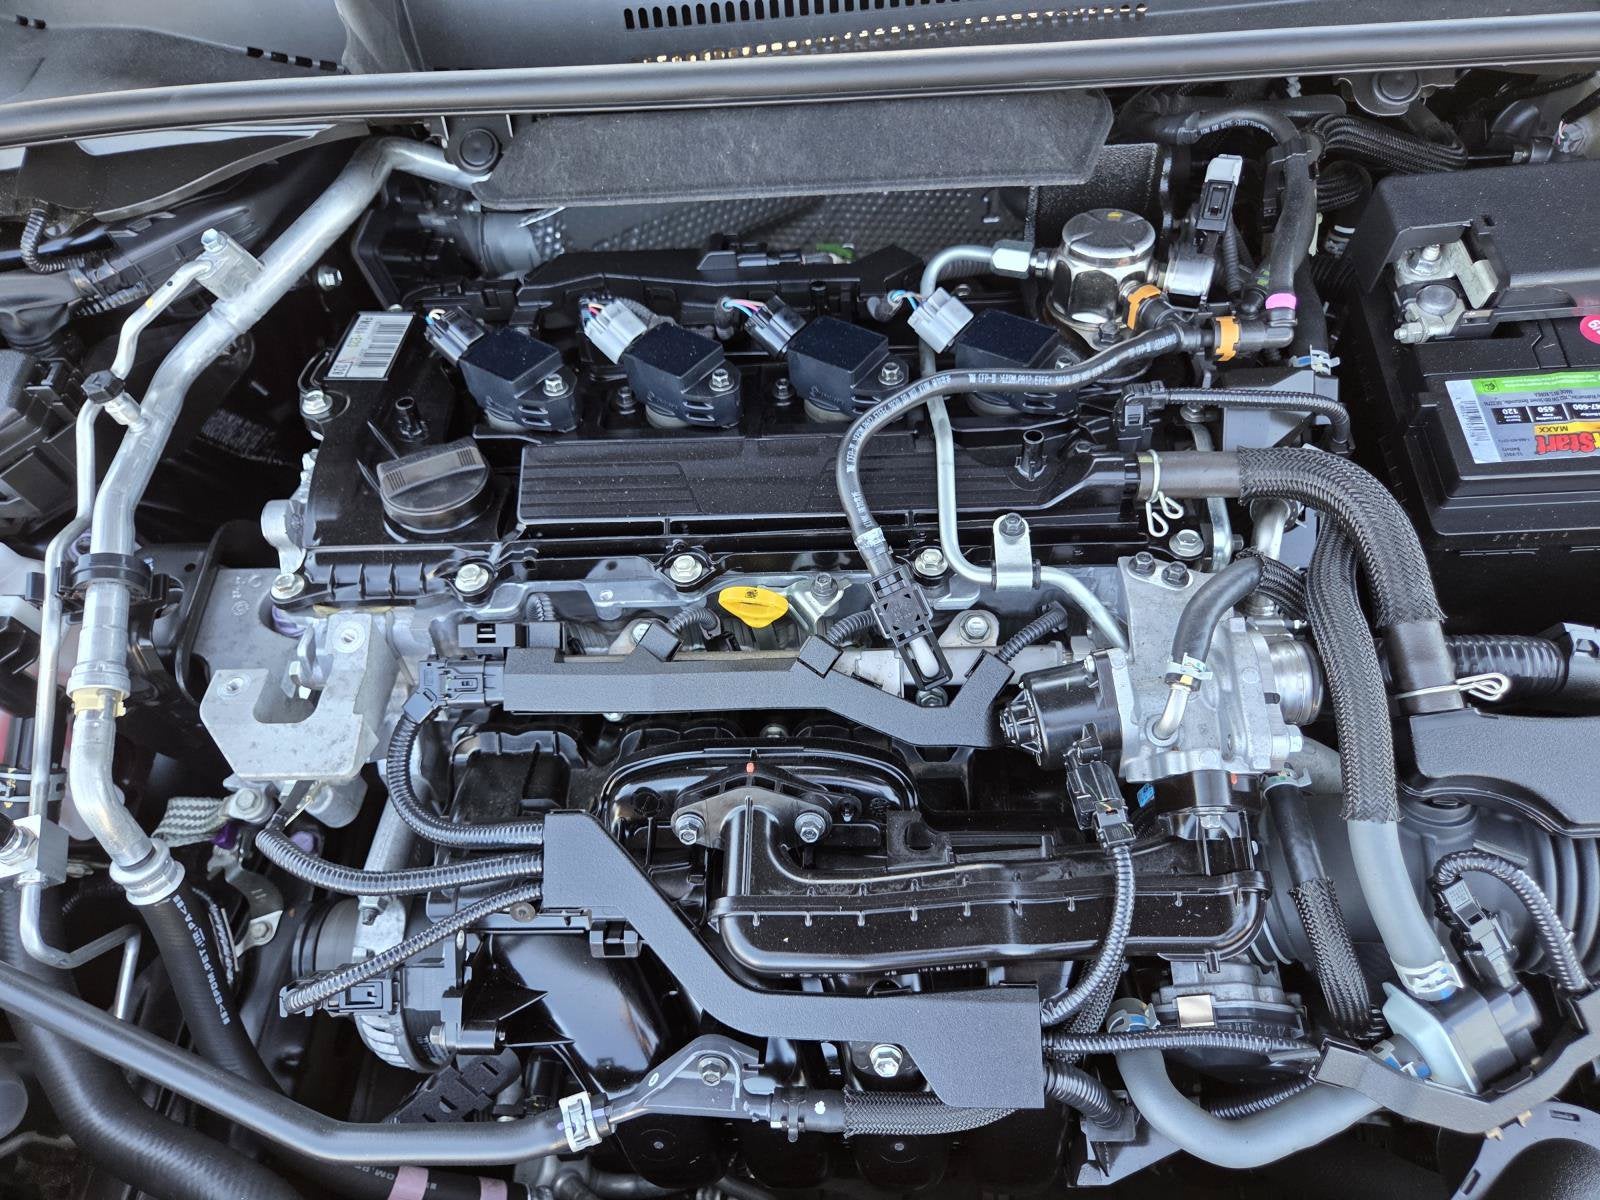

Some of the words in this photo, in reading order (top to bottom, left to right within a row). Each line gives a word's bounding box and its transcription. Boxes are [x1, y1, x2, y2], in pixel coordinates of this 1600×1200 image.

[1501, 407, 1519, 415] 120
[1537, 405, 1555, 413] 650
[1539, 425, 1569, 433] MAXX
